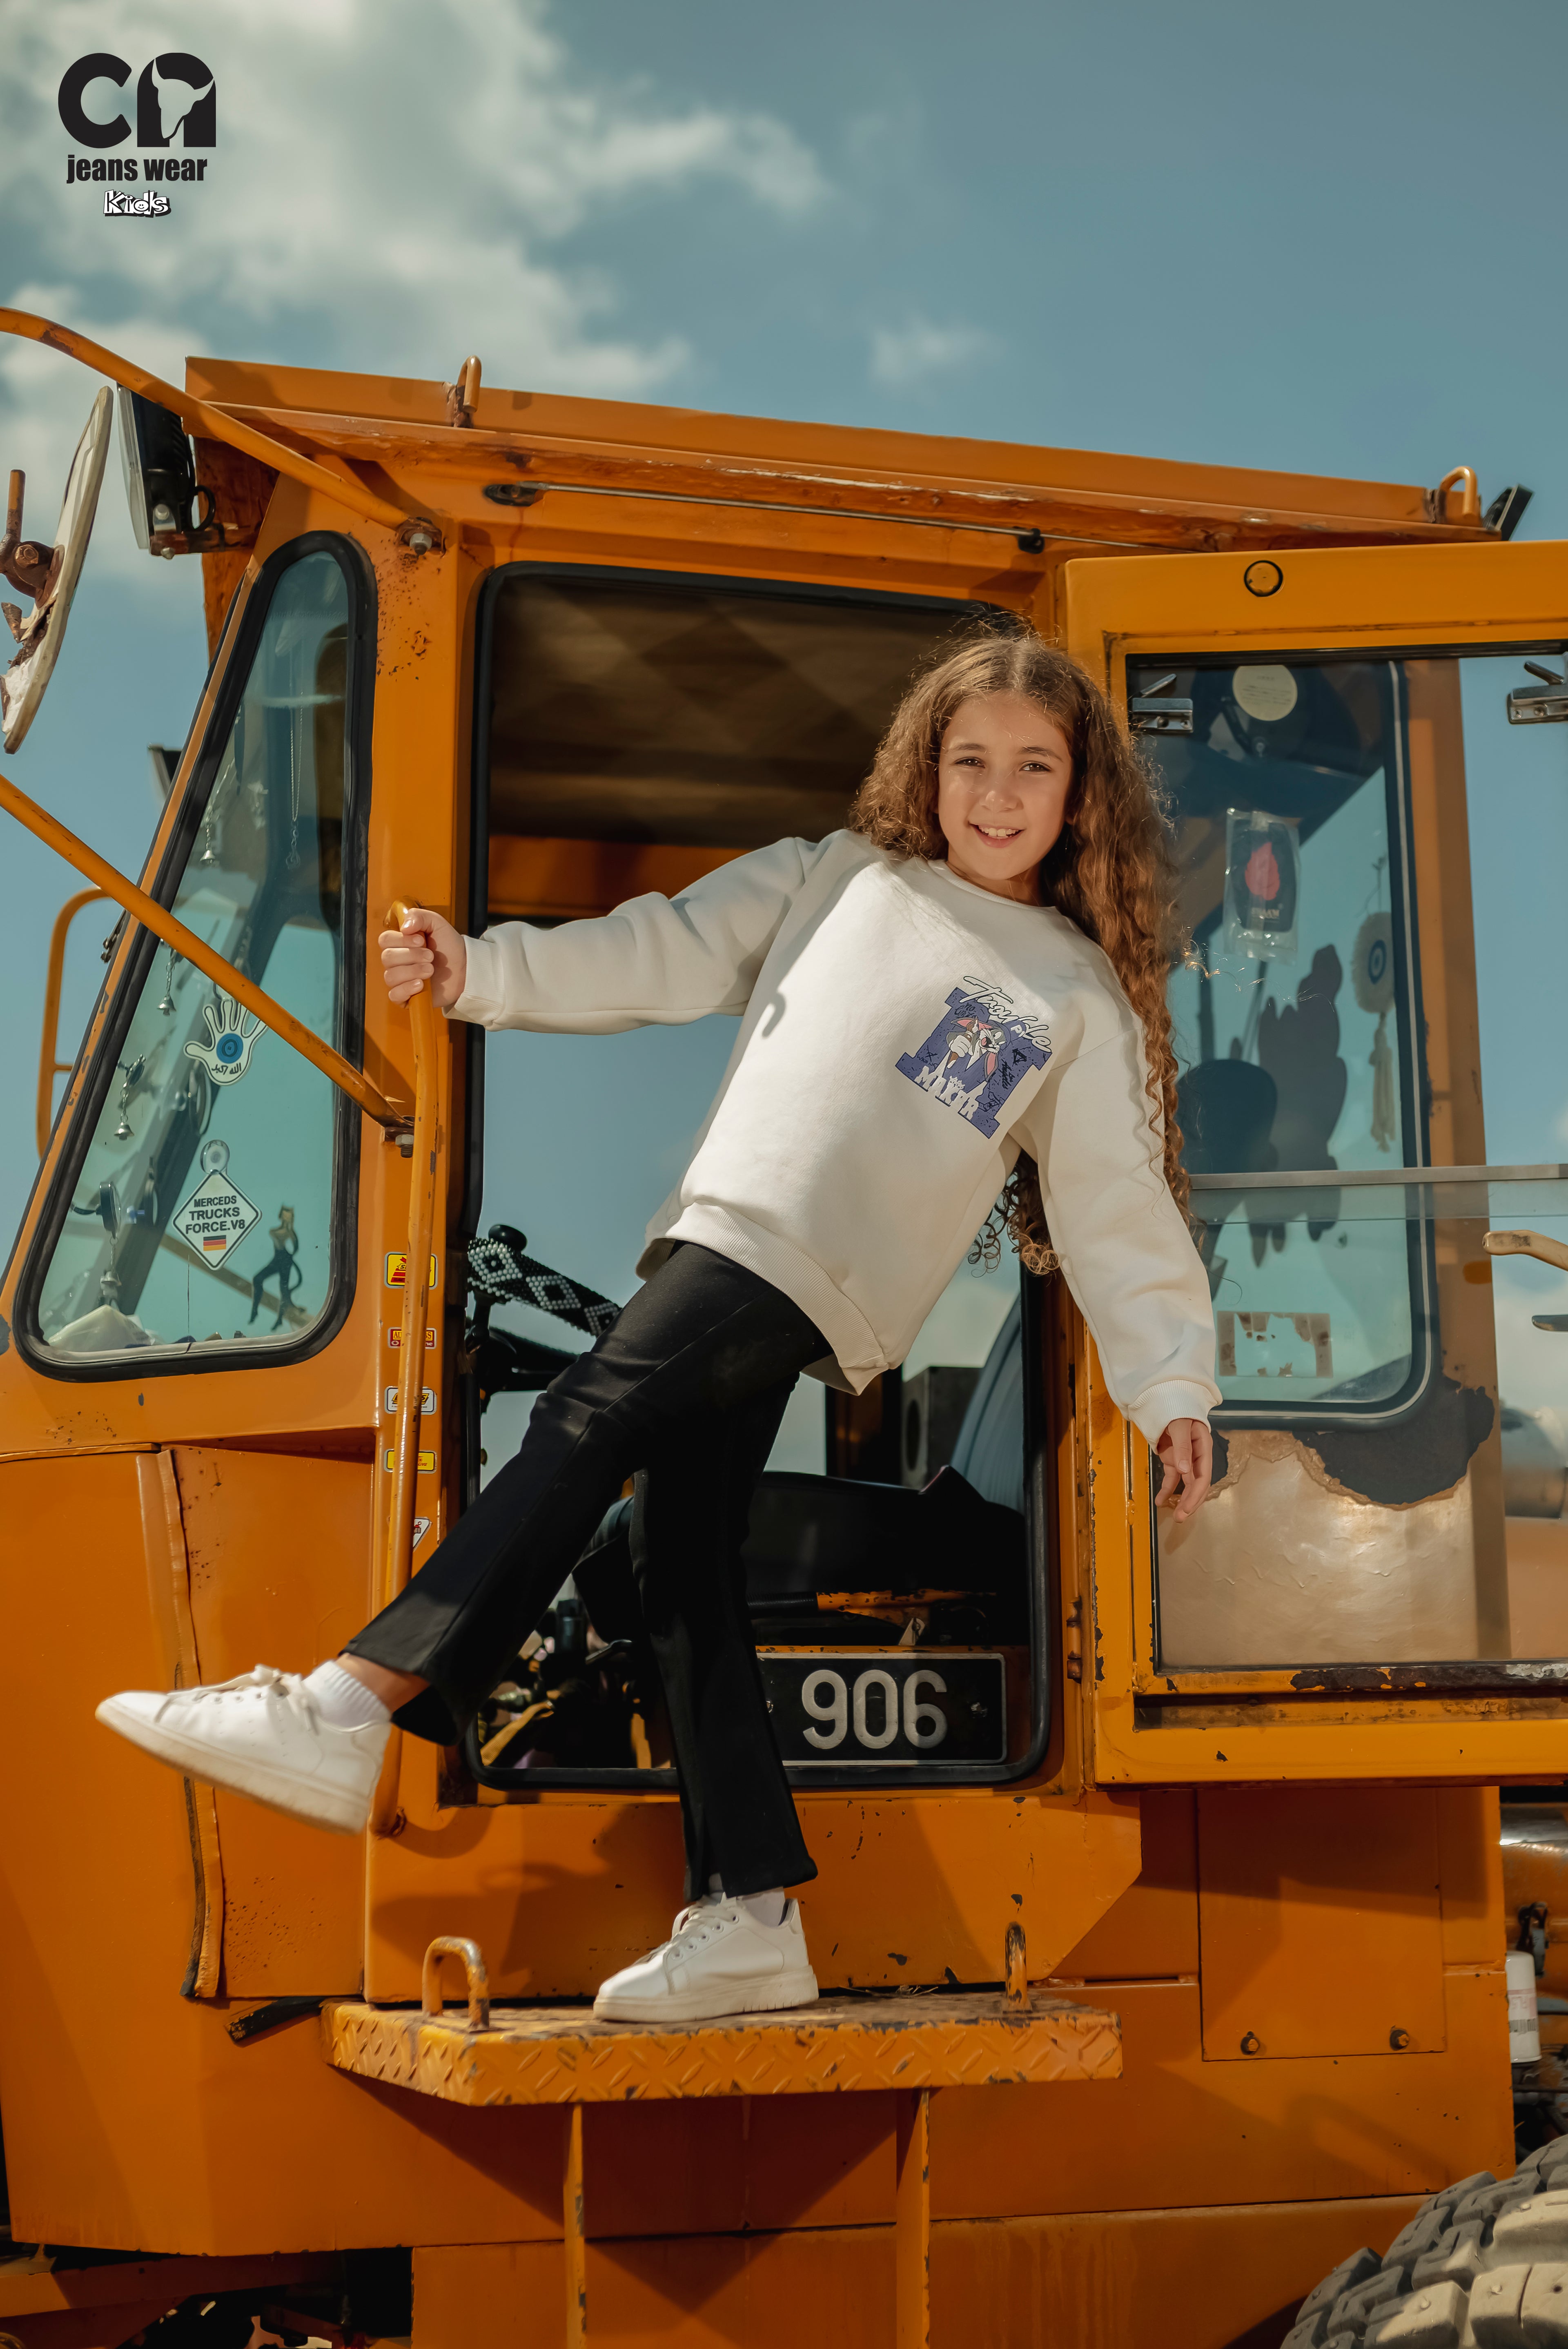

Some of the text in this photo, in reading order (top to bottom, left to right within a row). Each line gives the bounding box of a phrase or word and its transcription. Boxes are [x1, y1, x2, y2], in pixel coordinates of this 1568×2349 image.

[229, 1062, 241, 1074] الله
[194, 1195, 237, 1208] MERCEDS
[189, 1207, 240, 1221] TRUCKS
[802, 1669, 947, 1749] 906
